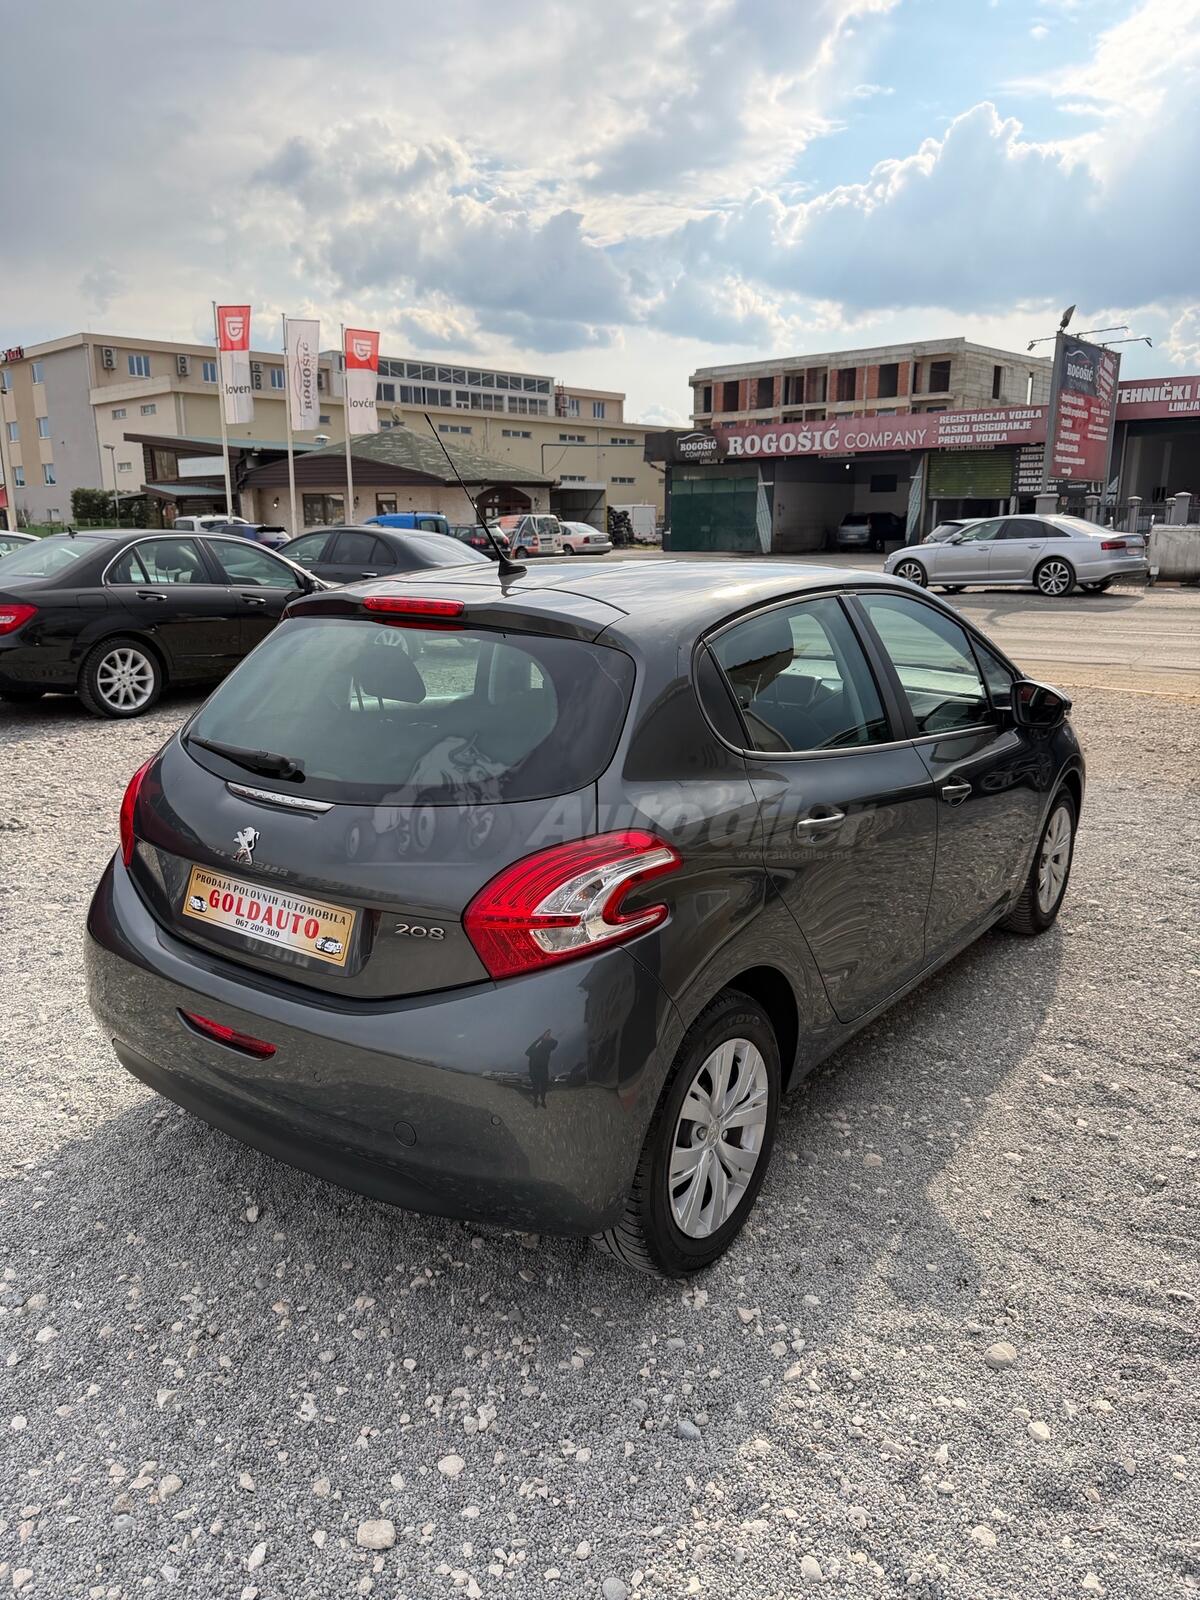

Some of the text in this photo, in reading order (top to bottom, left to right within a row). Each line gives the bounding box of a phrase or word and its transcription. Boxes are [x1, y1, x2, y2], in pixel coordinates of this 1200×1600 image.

[1116, 382, 1192, 404] TEHNIČKI
[1168, 401, 1200, 412] LINIJA
[939, 409, 1043, 425] REGISTRACIJA VOZILA
[938, 420, 1032, 435] KASKO OSIGURANJE
[680, 439, 717, 451] ROGOŠIĆ
[726, 423, 928, 456] ROGOŠIĆ COMPANY
[937, 432, 1008, 445] PREVOD VOZILA
[685, 450, 713, 459] COMPANY
[195, 872, 346, 926] PRODAJA POLOVNIH AUTOMOBILA
[209, 889, 320, 940] GOLDAUTO
[235, 917, 280, 939] 067 209 309
[394, 923, 445, 940] 208
